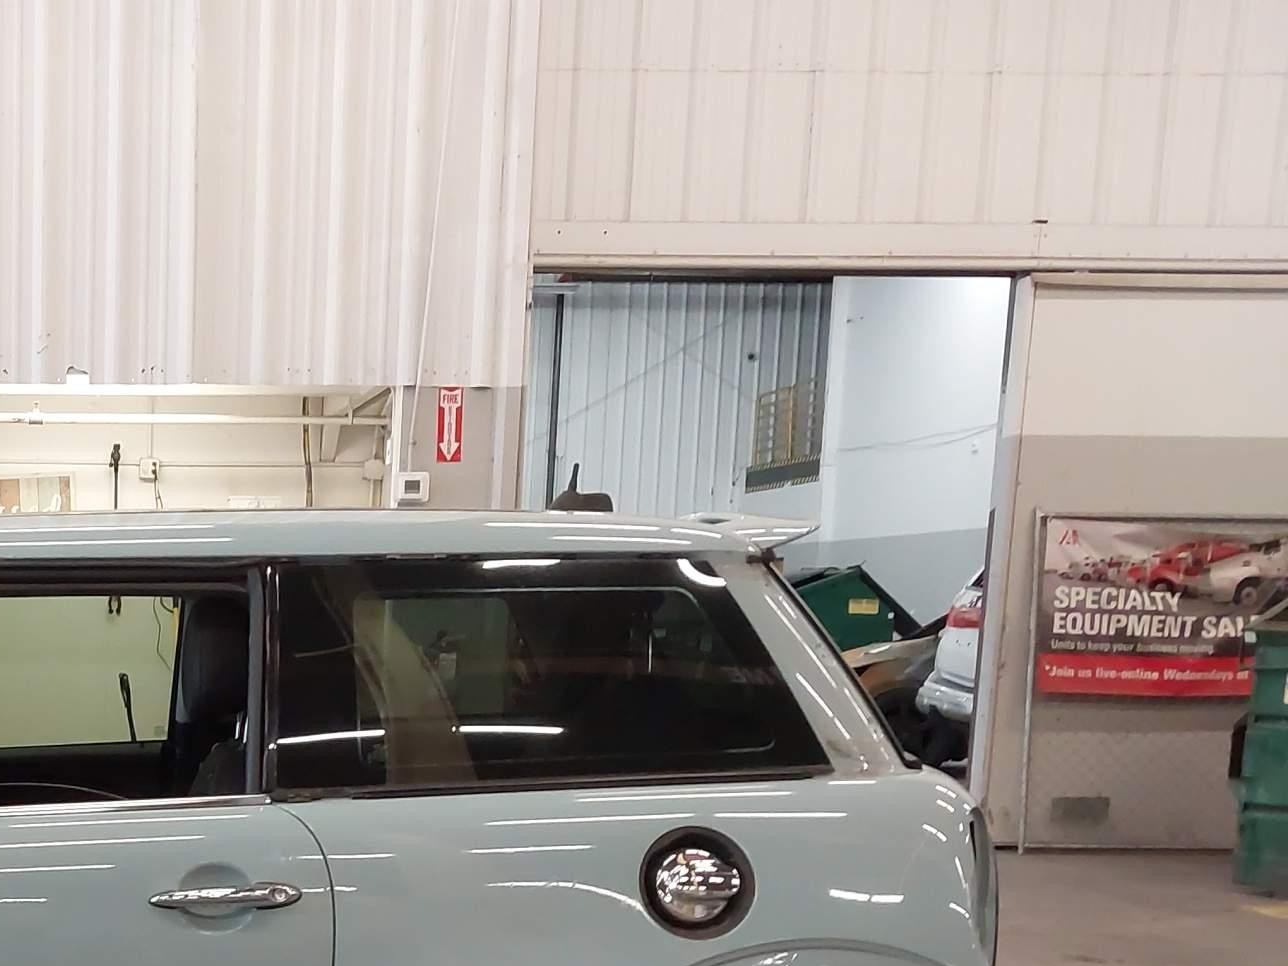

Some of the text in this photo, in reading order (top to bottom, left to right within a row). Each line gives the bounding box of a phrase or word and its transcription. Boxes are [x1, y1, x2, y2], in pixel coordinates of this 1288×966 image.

[442, 393, 460, 405] FIRE
[1054, 585, 1182, 612] SPECIALTY
[1052, 612, 1259, 639] EQUIPMENT SAL
